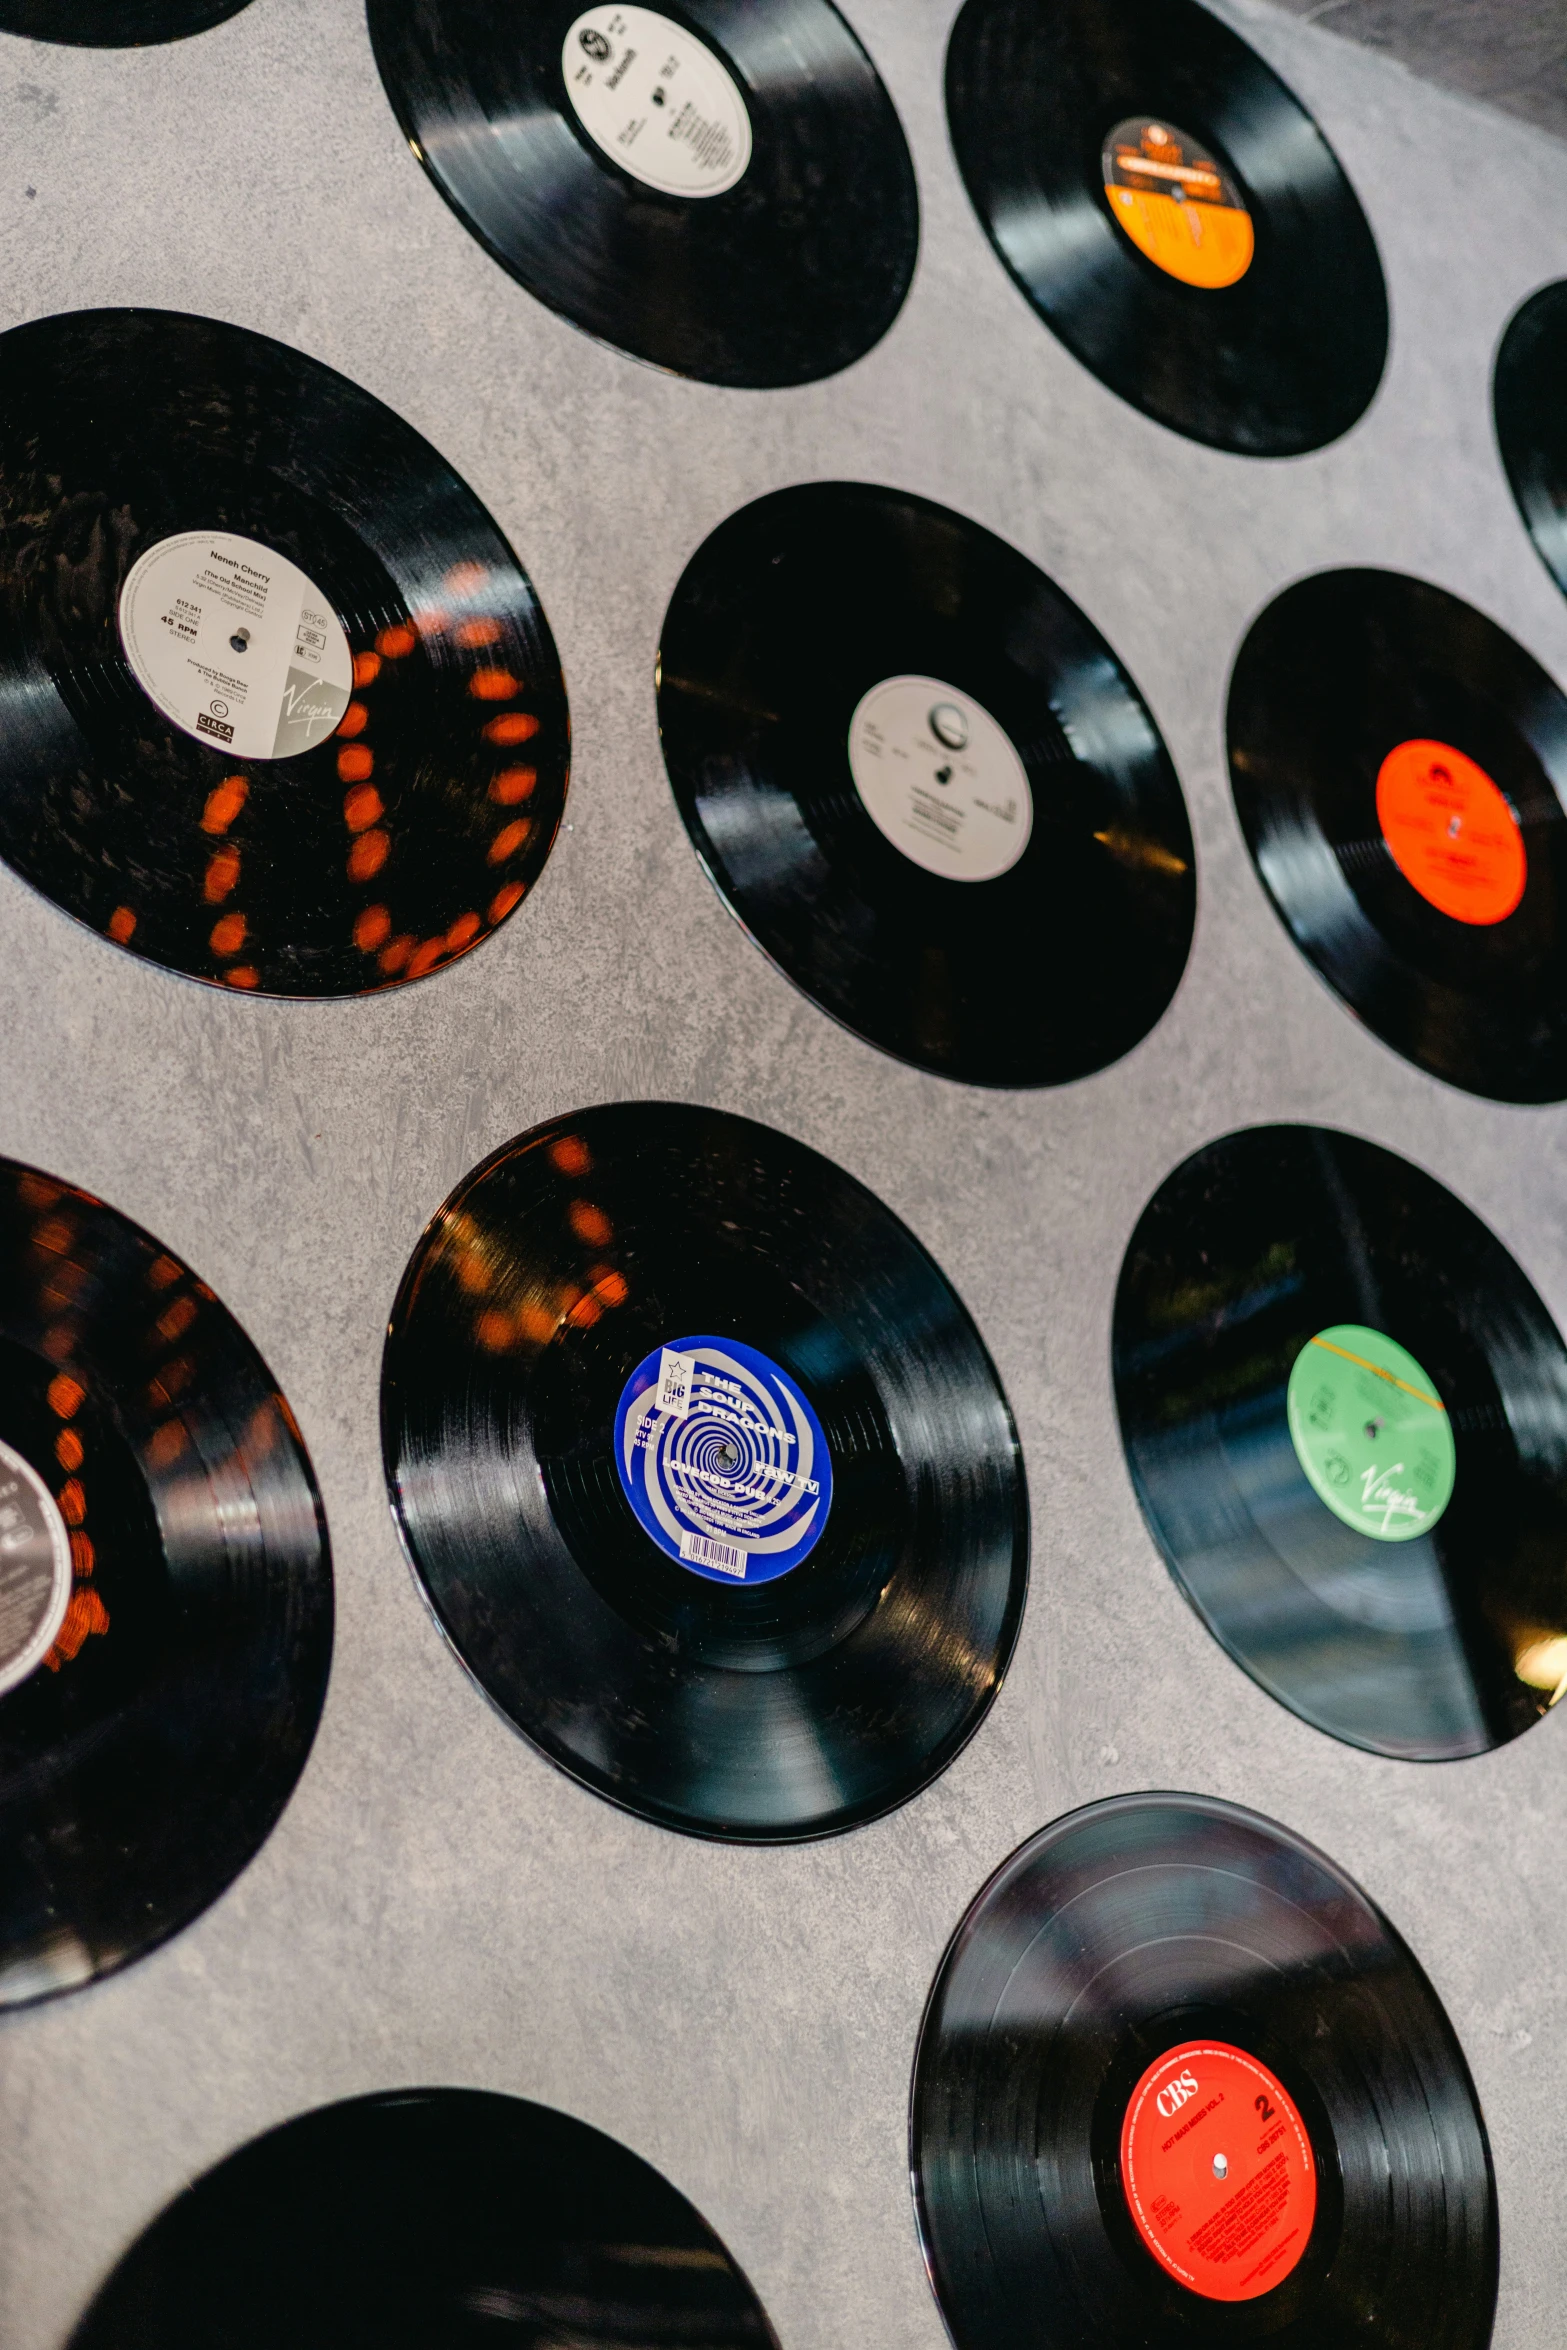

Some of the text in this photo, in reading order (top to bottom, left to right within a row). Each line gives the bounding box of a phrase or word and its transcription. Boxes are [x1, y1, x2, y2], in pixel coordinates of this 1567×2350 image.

[211, 551, 270, 583] Neneh Cherry
[193, 580, 206, 588] Virgin
[207, 586, 221, 595] Music
[204, 570, 218, 579] (The
[231, 582, 252, 594] School
[253, 592, 266, 601] Mix)
[234, 574, 267, 593] Manchild
[177, 599, 201, 613] 612 341
[221, 598, 262, 618] Copyright Control
[169, 610, 198, 626] SIDE ONE
[304, 612, 313, 620] ST
[161, 616, 197, 636] 45 RPM
[170, 629, 195, 644] STEREO
[187, 659, 211, 672] Produced
[214, 688, 234, 700] Records
[232, 683, 247, 693] Bunch
[283, 679, 341, 737] Virgin
[199, 716, 232, 735] CIRCA
[664, 1378, 685, 1398] BIG
[702, 1371, 741, 1394] THE
[663, 1394, 683, 1409] LIFE
[699, 1387, 755, 1412] SOUP
[636, 1413, 666, 1434] SIDE 2
[698, 1401, 796, 1445] DRAGONS
[635, 1428, 646, 1439] RTV
[633, 1437, 655, 1452] 45 RPM
[662, 1457, 731, 1488] LOVEGOD
[734, 1482, 766, 1501] DUB
[755, 1462, 818, 1493] raw TV
[1361, 1463, 1426, 1533] Virgin
[713, 1526, 727, 1538] BPM
[741, 1528, 761, 1539] ENGLAND
[691, 1553, 715, 1567] 016721
[716, 1562, 741, 1576] 219497
[1156, 2069, 1199, 2117] CBS
[1255, 2094, 1275, 2122] 2
[1162, 2137, 1174, 2152] HOT
[1174, 2124, 1190, 2140] MAXI
[1188, 2109, 1207, 2128] MIXES
[1218, 2093, 1224, 2101] 2
[1257, 2140, 1270, 2154] CBS
[1156, 2202, 1174, 2221] STEREO
